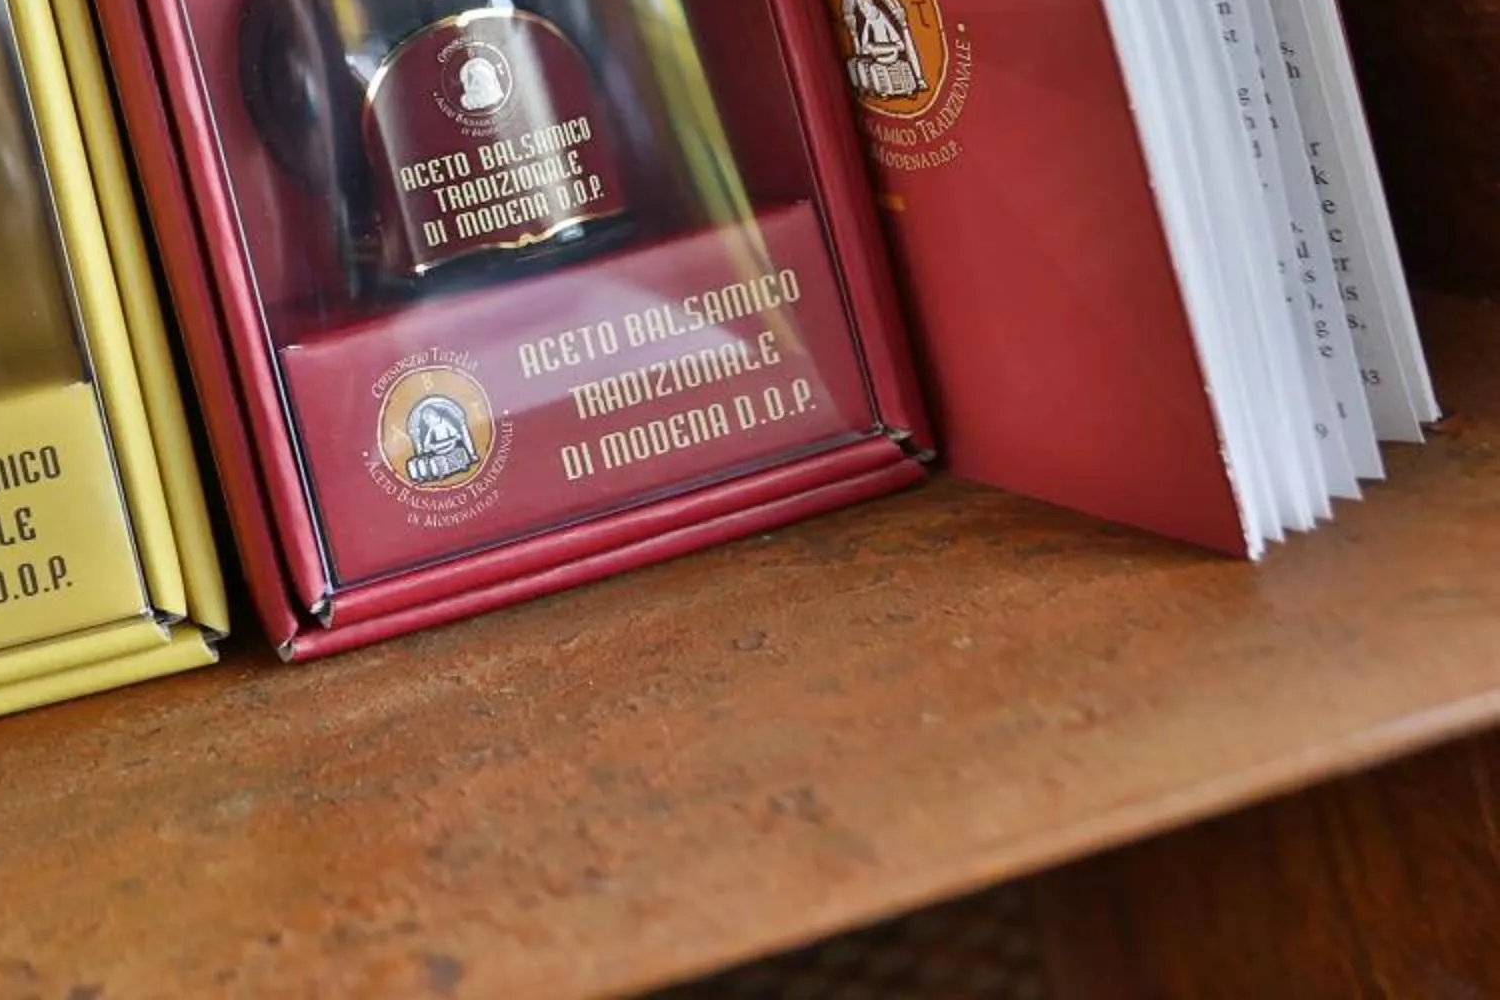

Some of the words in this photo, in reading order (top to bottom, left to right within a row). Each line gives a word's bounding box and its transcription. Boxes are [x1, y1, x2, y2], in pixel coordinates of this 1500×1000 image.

[400, 153, 471, 191] ACETO
[477, 116, 592, 172] BALSAMICO
[433, 150, 583, 213] TRADIZIONALE
[423, 219, 448, 247] DI
[456, 192, 551, 241] MODENA
[556, 175, 605, 211] D.O.P.
[518, 320, 618, 379] ACETO
[624, 268, 801, 348] BALSAMICO
[569, 330, 781, 420] TRADIZIONALE
[561, 441, 594, 481] DI
[599, 402, 730, 470] MODENA
[734, 378, 817, 430] D.O.P.
